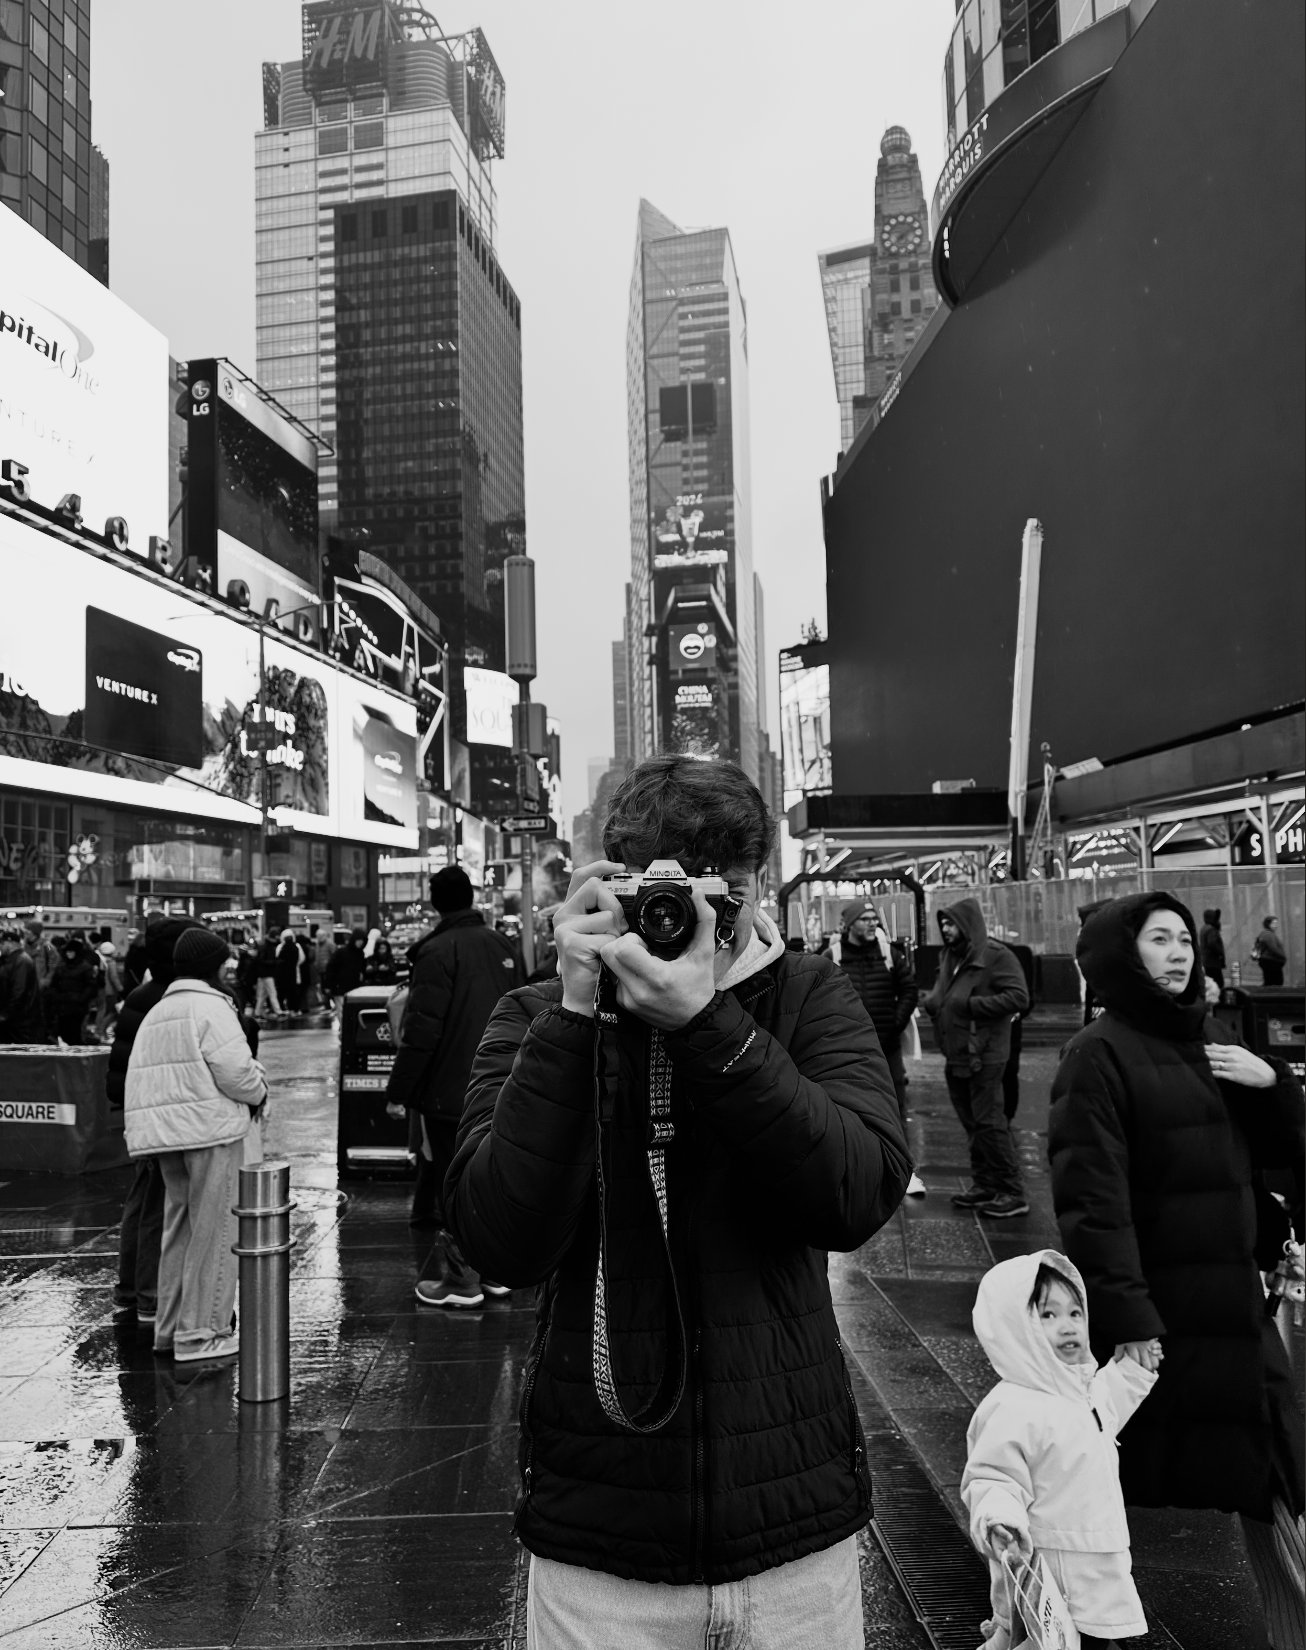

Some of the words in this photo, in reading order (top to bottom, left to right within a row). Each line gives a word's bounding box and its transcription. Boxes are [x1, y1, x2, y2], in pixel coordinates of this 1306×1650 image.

[939, 113, 989, 192] MARRIOTT
[940, 142, 982, 211] MARQUIS
[233, 386, 247, 409] LG
[192, 403, 210, 416] LG
[96, 675, 150, 705] VENTURE
[150, 692, 158, 706] X
[527, 820, 542, 828] WAY
[649, 870, 682, 878] MINOLTA
[345, 1079, 379, 1088] TIMES
